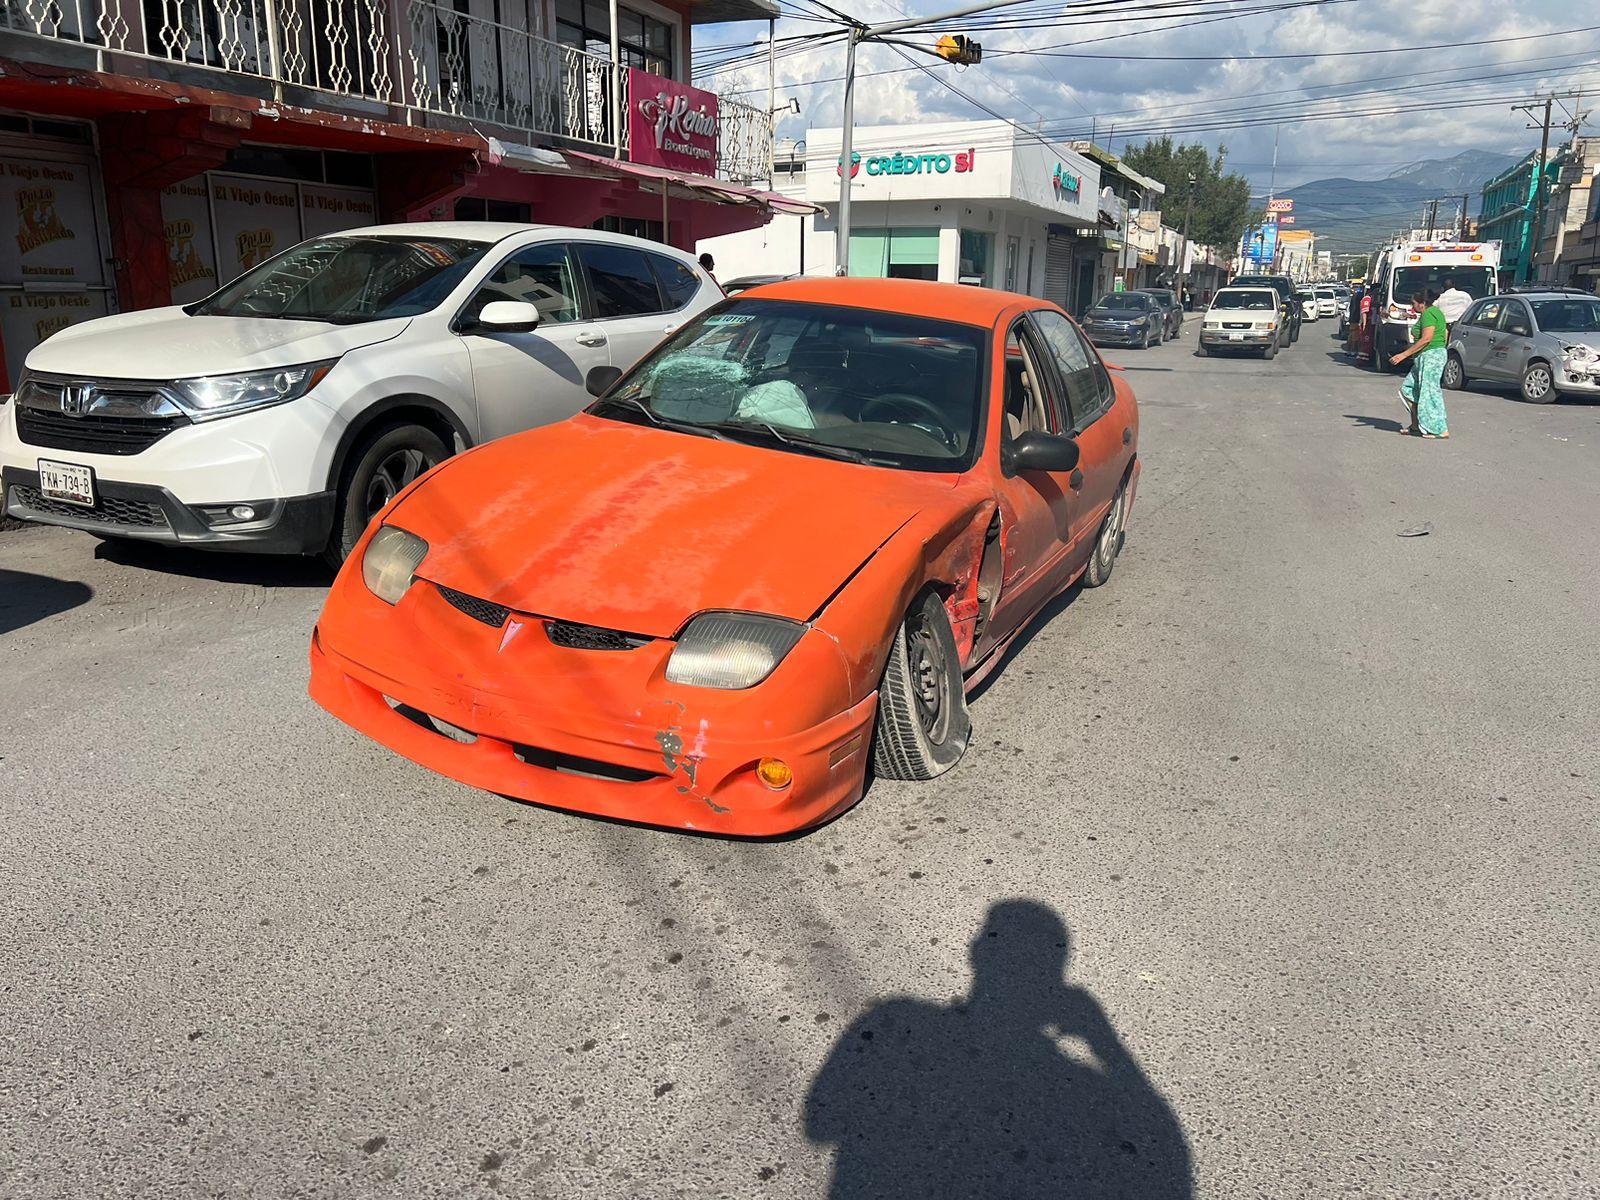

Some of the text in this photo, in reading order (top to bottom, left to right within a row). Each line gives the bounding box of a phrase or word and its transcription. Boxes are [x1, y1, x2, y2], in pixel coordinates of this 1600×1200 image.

[664, 139, 711, 159] Boutique
[866, 148, 975, 176] CRÉDITO SÍ
[215, 186, 295, 208] El Viejo Oeste
[304, 195, 373, 214] El Viejo Oeste
[10, 294, 91, 309] El Viejo Oeste
